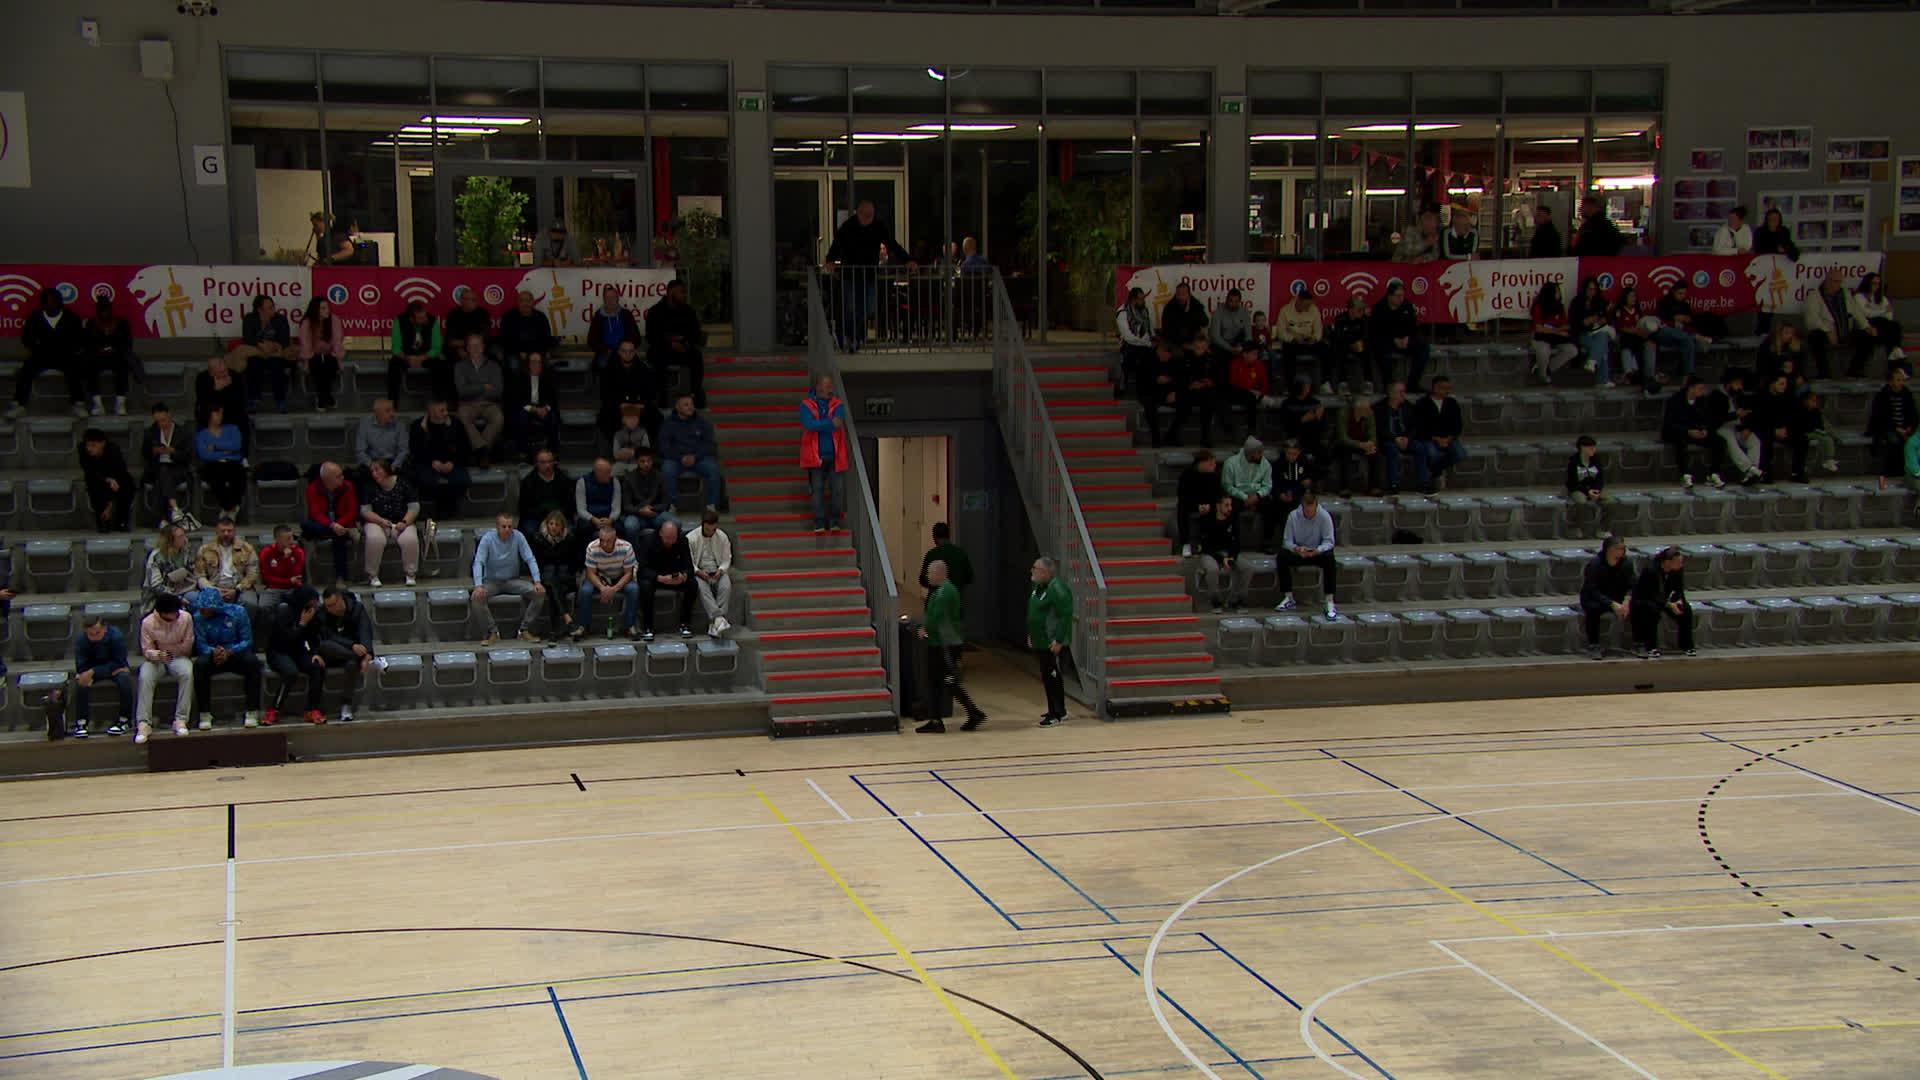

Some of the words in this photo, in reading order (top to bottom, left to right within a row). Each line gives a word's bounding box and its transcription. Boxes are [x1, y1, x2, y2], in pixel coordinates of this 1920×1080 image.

[202, 156, 218, 174] G
[203, 277, 302, 297] Province
[1491, 292, 1513, 309] de
[205, 303, 233, 324] de
